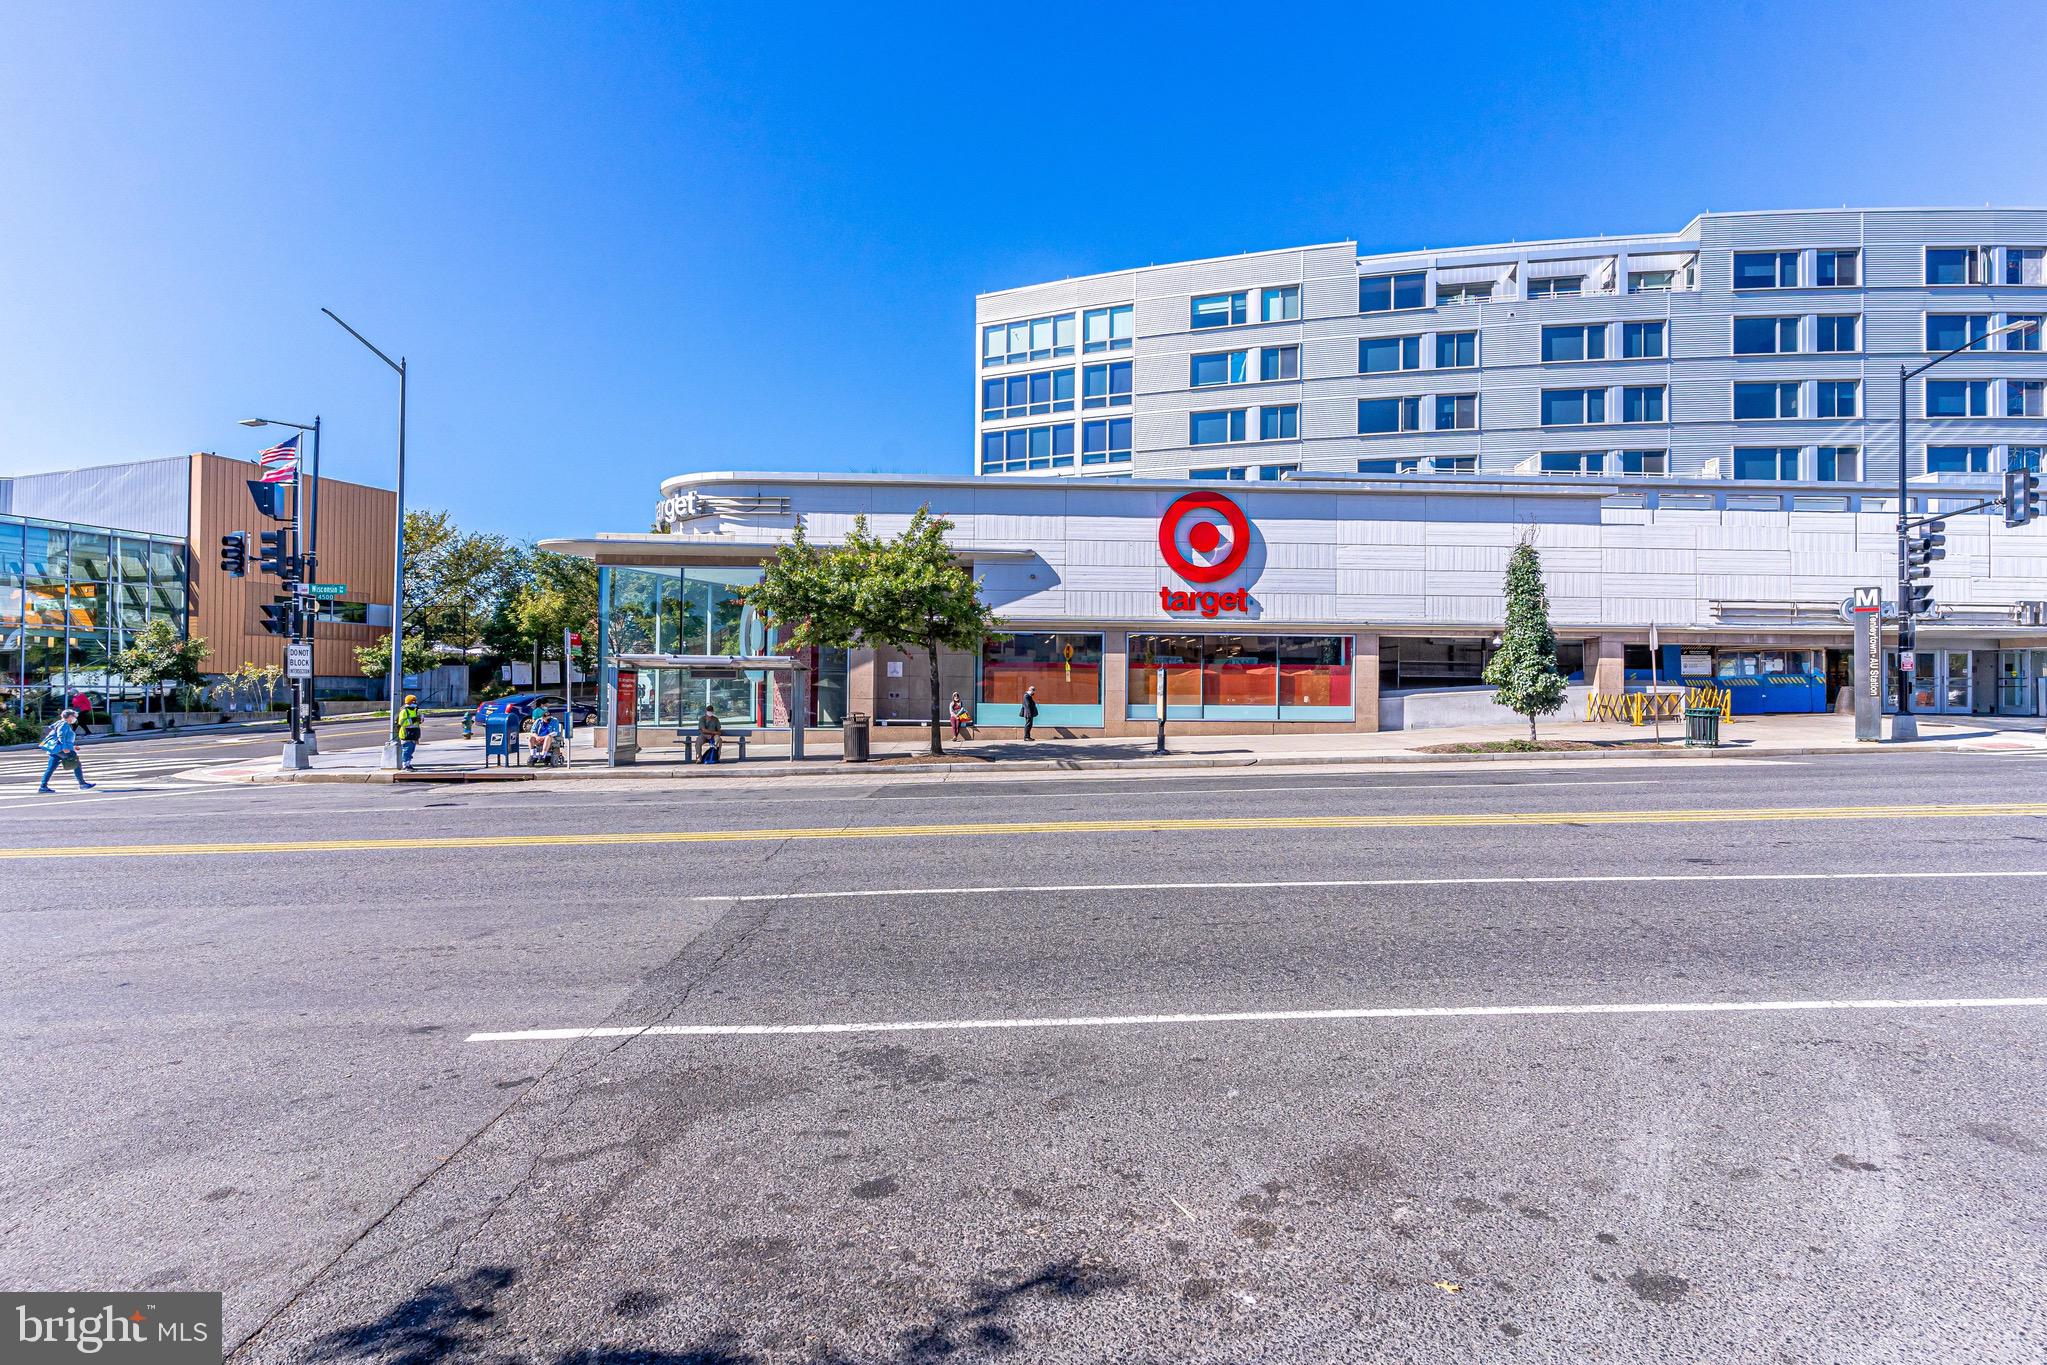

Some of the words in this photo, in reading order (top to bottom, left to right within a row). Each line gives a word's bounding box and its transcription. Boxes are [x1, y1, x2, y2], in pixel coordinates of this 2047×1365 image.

[656, 491, 697, 522] arget
[311, 585, 338, 593] Wisconsin
[1159, 586, 1248, 618] target
[1855, 589, 1879, 607] M
[1869, 613, 1879, 654] Tenleytown
[1870, 658, 1879, 669] AU
[1870, 670, 1879, 696] Station
